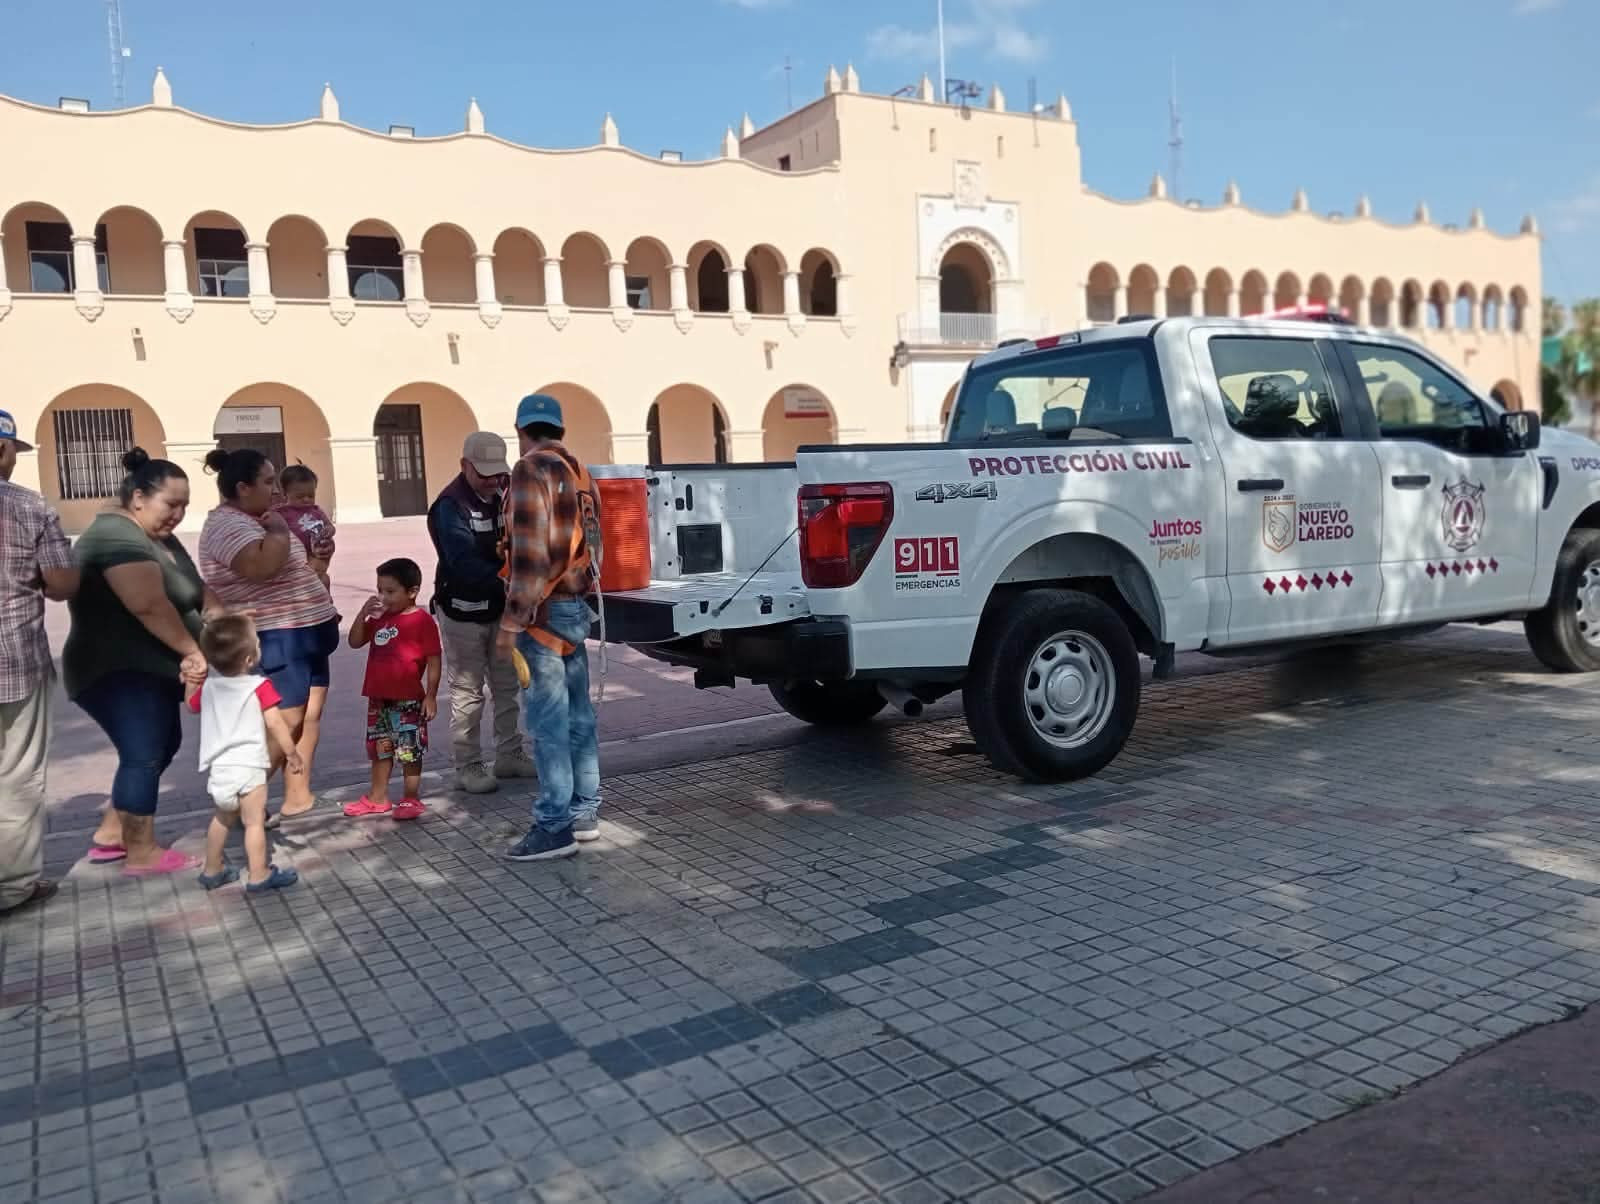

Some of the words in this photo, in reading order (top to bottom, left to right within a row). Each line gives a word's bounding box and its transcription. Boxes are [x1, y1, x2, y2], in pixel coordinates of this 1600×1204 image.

[968, 449, 1128, 477] PROTECCIÓN
[1132, 451, 1191, 470] CIVIL
[1298, 509, 1349, 526] NUEVO
[1149, 518, 1202, 538] Juntos
[1298, 525, 1355, 542] LAREDO
[899, 541, 956, 568] 911
[1158, 537, 1201, 569] posible
[895, 579, 961, 592] EMERGENCIAS
